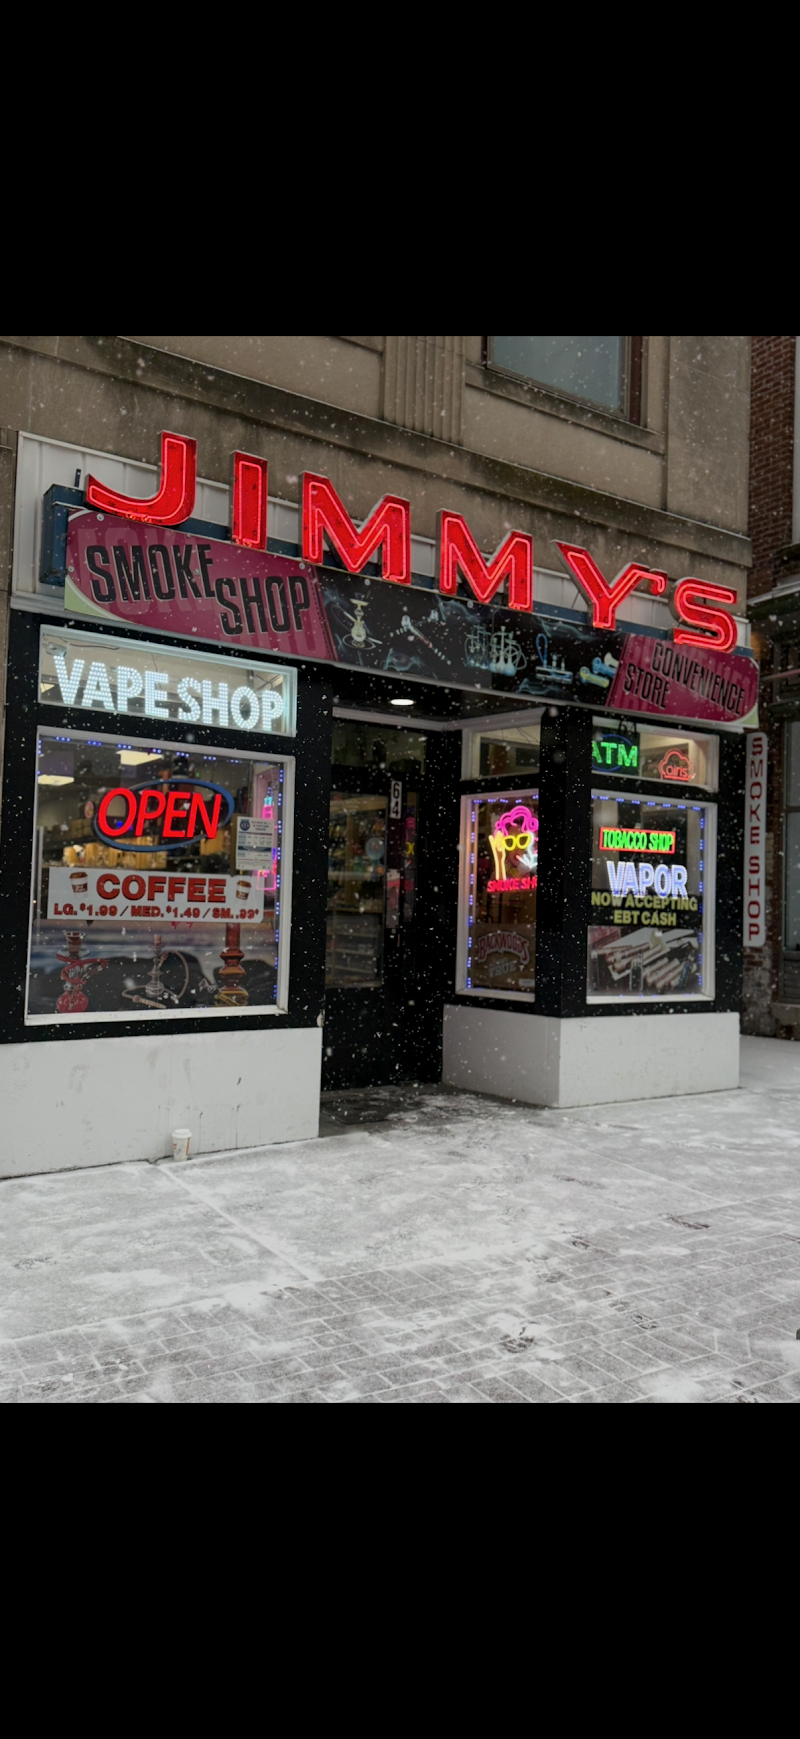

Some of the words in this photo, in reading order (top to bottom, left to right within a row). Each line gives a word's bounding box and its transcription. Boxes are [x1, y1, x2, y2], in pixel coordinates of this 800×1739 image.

[85, 430, 738, 653] JIMMY'S
[86, 544, 215, 604] SMOKE
[214, 576, 310, 636] SHOP
[54, 655, 169, 718] VAPE
[177, 676, 284, 731] SHOP
[623, 663, 671, 710] STORE
[651, 642, 745, 716] CONVENIENCE
[591, 740, 638, 767] ATM
[392, 782, 401, 818] 64
[749, 736, 764, 845] SMOKE
[98, 787, 222, 839] OPEN
[602, 829, 648, 850] TOBACCO
[648, 832, 674, 851] SHOP
[96, 873, 227, 903] COFFEE
[487, 878, 520, 893] SMOKE
[606, 860, 689, 900] VAPOR
[747, 855, 762, 941] SHOP
[53, 903, 78, 916] LG.
[79, 903, 118, 917] $1.99
[119, 905, 129, 917] /
[130, 906, 164, 918] MED.
[166, 905, 201, 919] $1.49
[202, 907, 211, 918] /
[212, 907, 234, 919] SM.
[591, 891, 623, 907] NOW
[624, 894, 698, 911] ACCEPTING
[613, 909, 640, 924] EBT
[641, 910, 677, 926] CASH
[477, 929, 531, 966] BACKWOODS
[489, 961, 517, 978] TRUE
